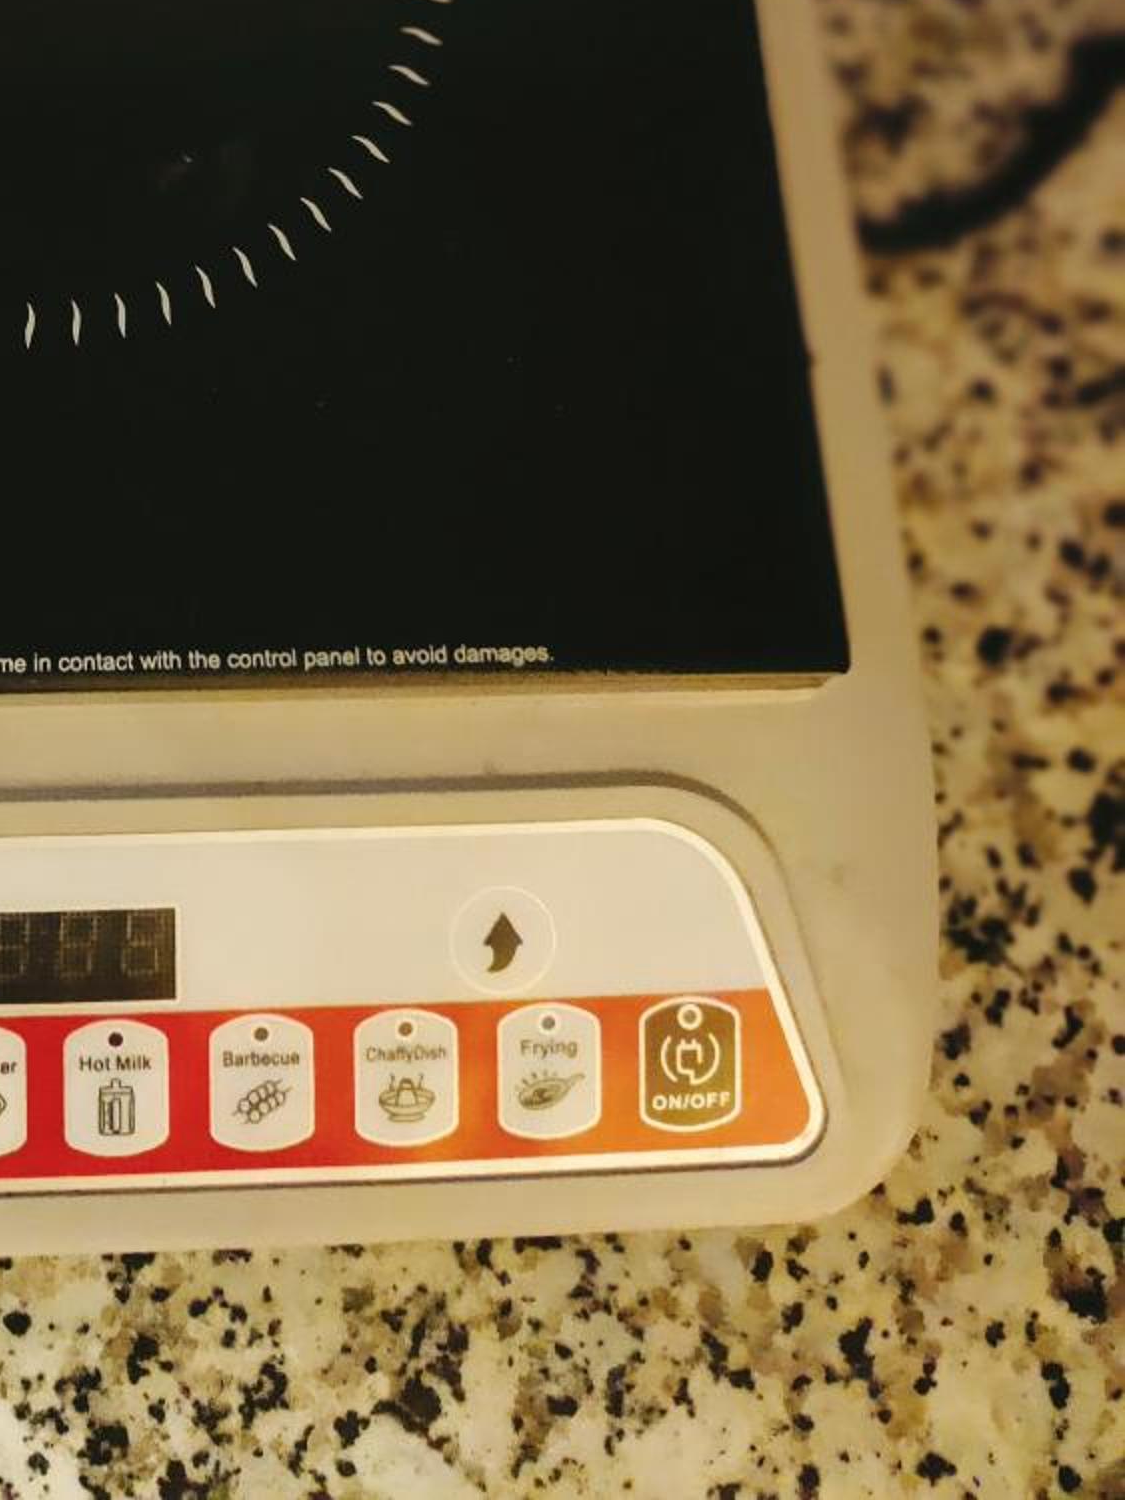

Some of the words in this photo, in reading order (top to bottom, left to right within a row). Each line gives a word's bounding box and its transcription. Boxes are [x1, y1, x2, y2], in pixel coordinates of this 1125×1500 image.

[32, 653, 52, 672] in
[58, 653, 135, 672] contact
[139, 650, 182, 670] with
[187, 650, 222, 669] the
[226, 649, 297, 668] control
[303, 648, 360, 671] panel
[366, 647, 386, 666] to
[392, 645, 447, 665] avoid
[453, 644, 555, 668] damages.
[222, 1050, 300, 1068] Barbecue
[519, 1038, 579, 1060] Frying
[78, 1055, 111, 1072] Hot
[116, 1053, 152, 1071] Milk
[651, 1091, 731, 1111] ON/OFF
